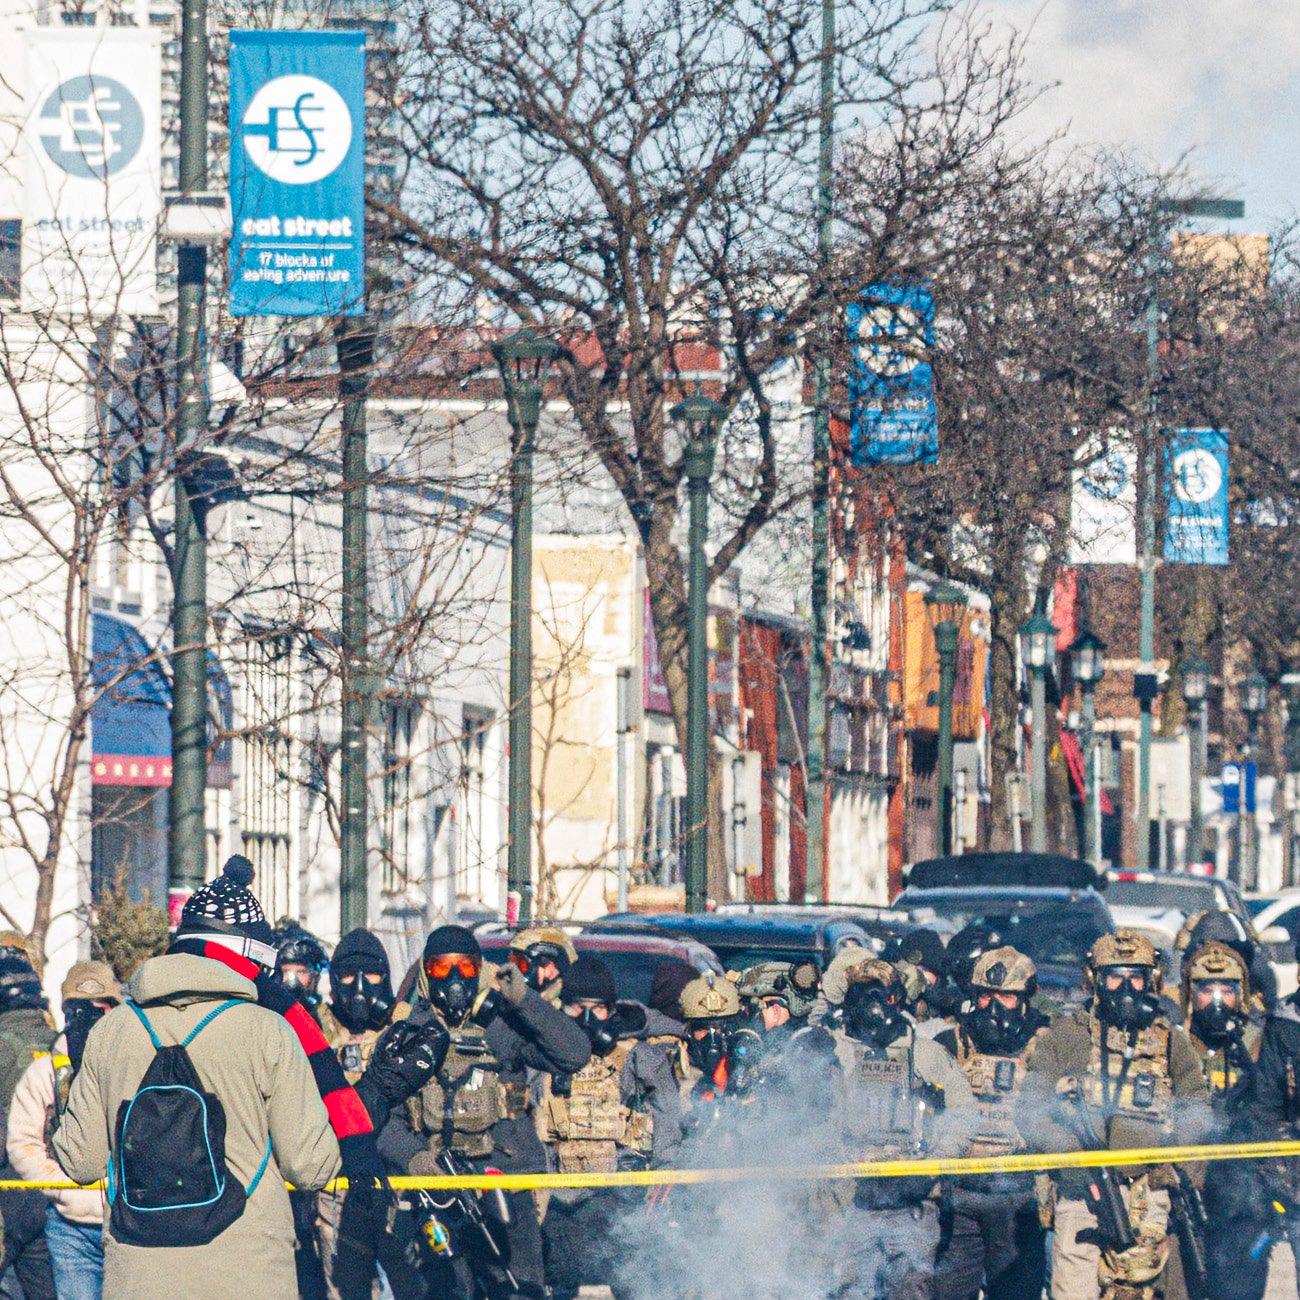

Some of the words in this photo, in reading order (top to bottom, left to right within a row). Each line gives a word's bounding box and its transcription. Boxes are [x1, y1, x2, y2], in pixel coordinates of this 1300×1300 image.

[37, 216, 73, 231] eat
[78, 216, 145, 233] street
[242, 216, 281, 236] eat
[283, 216, 353, 237] street
[259, 251, 272, 266] 17
[275, 253, 318, 268] blocks
[321, 253, 335, 267] of
[243, 268, 284, 284] eating
[286, 269, 350, 282] adventure
[862, 1062, 903, 1073] POLICE
